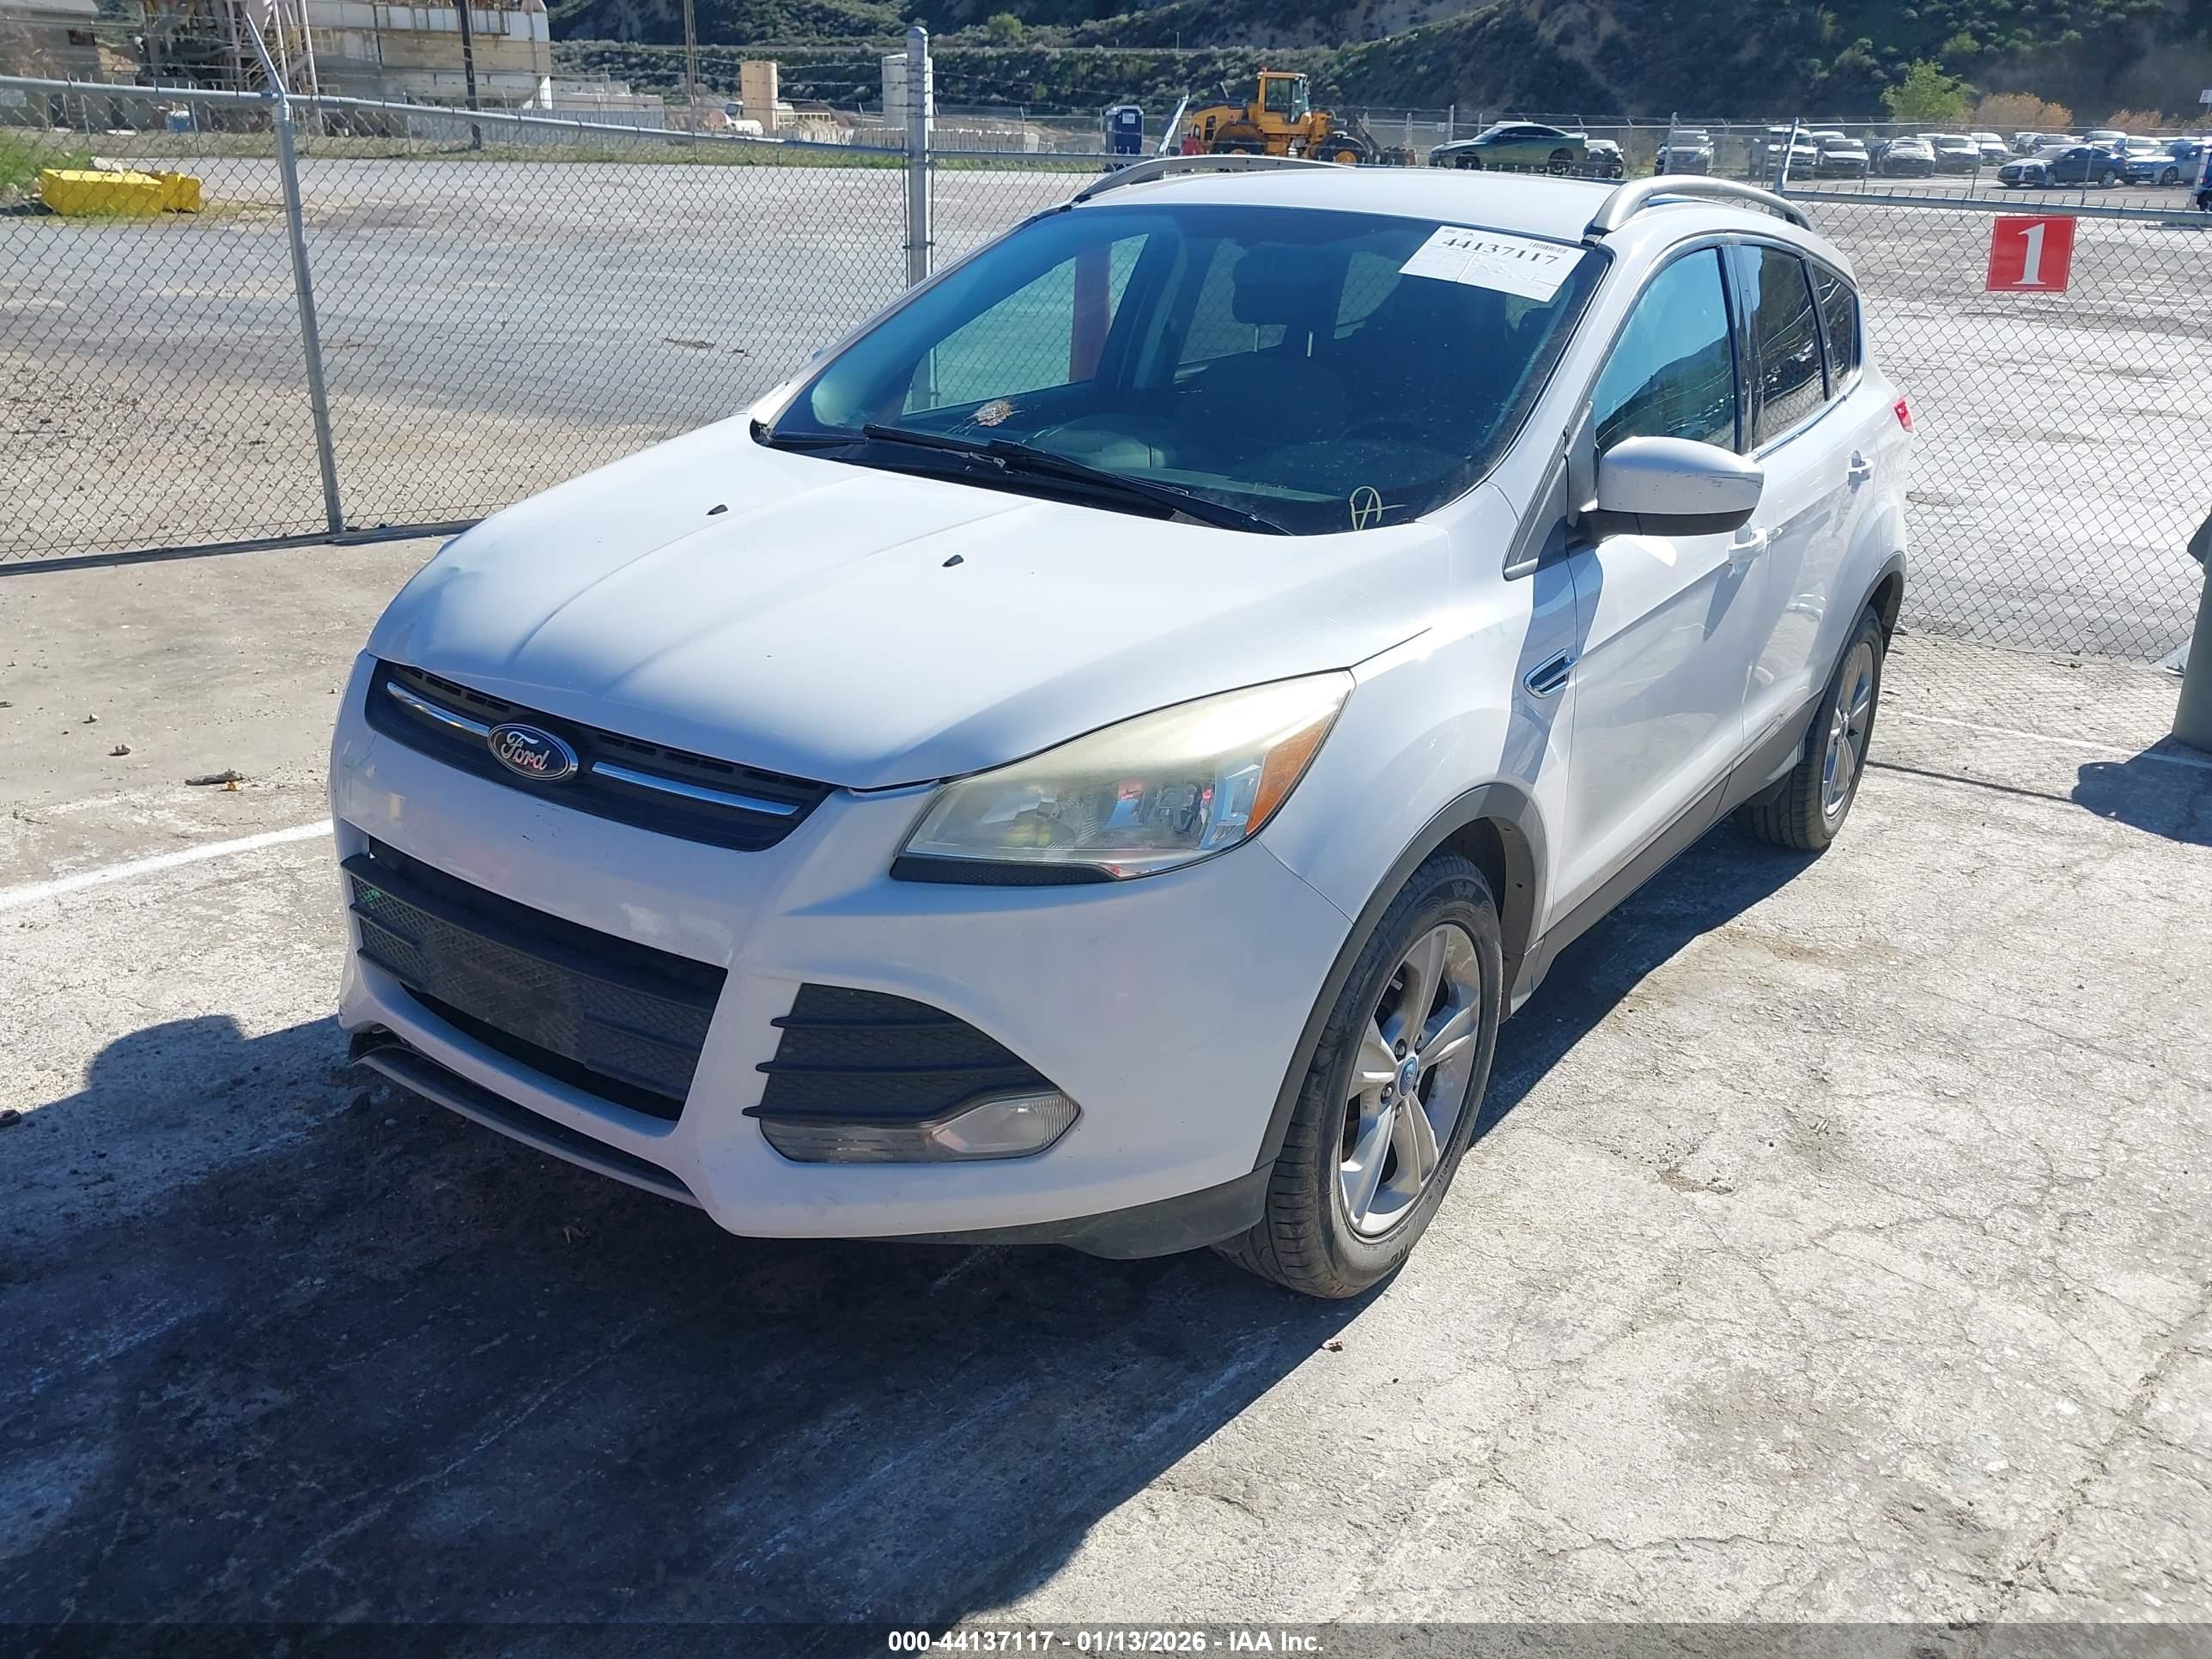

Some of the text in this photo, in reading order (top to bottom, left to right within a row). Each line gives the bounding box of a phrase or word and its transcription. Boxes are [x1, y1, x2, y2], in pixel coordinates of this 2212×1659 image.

[1443, 238, 1559, 265] 44137117
[2012, 222, 2046, 285] 1
[501, 731, 550, 770] Ford
